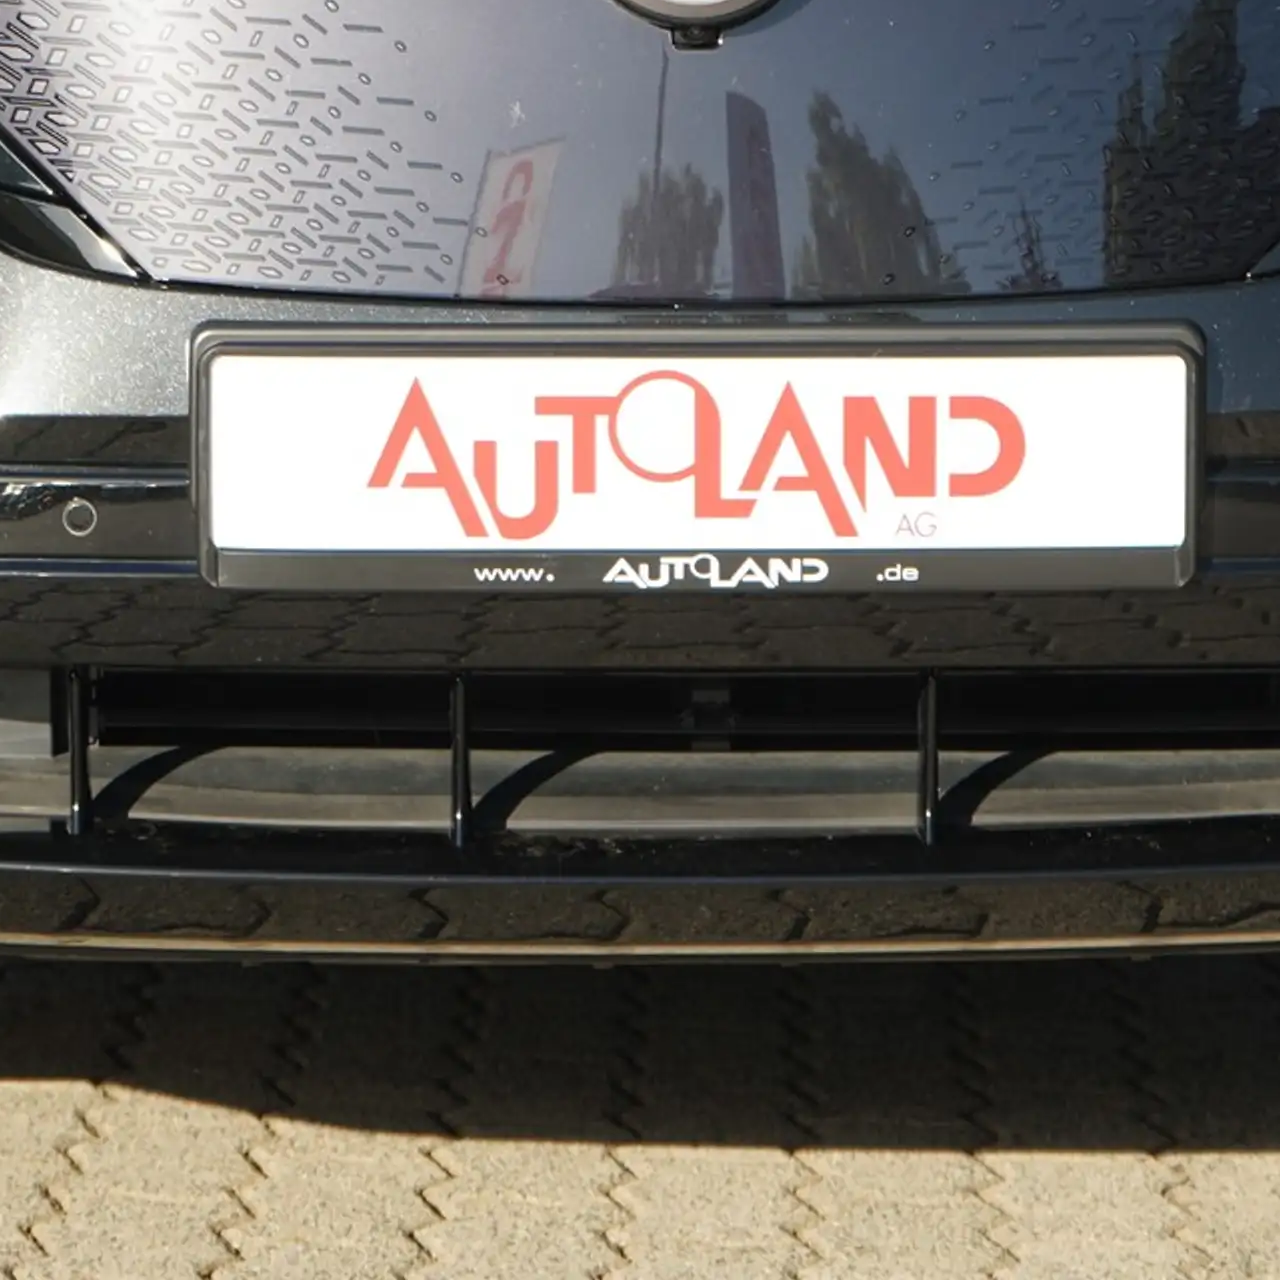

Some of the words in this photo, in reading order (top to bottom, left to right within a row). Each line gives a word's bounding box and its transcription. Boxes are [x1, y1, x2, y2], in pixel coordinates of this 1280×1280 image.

[368, 370, 1026, 541] AUTOLAND
[895, 511, 938, 537] AG
[473, 567, 556, 583] www.
[602, 552, 830, 590] AUTOLAND
[875, 563, 920, 582] .de
